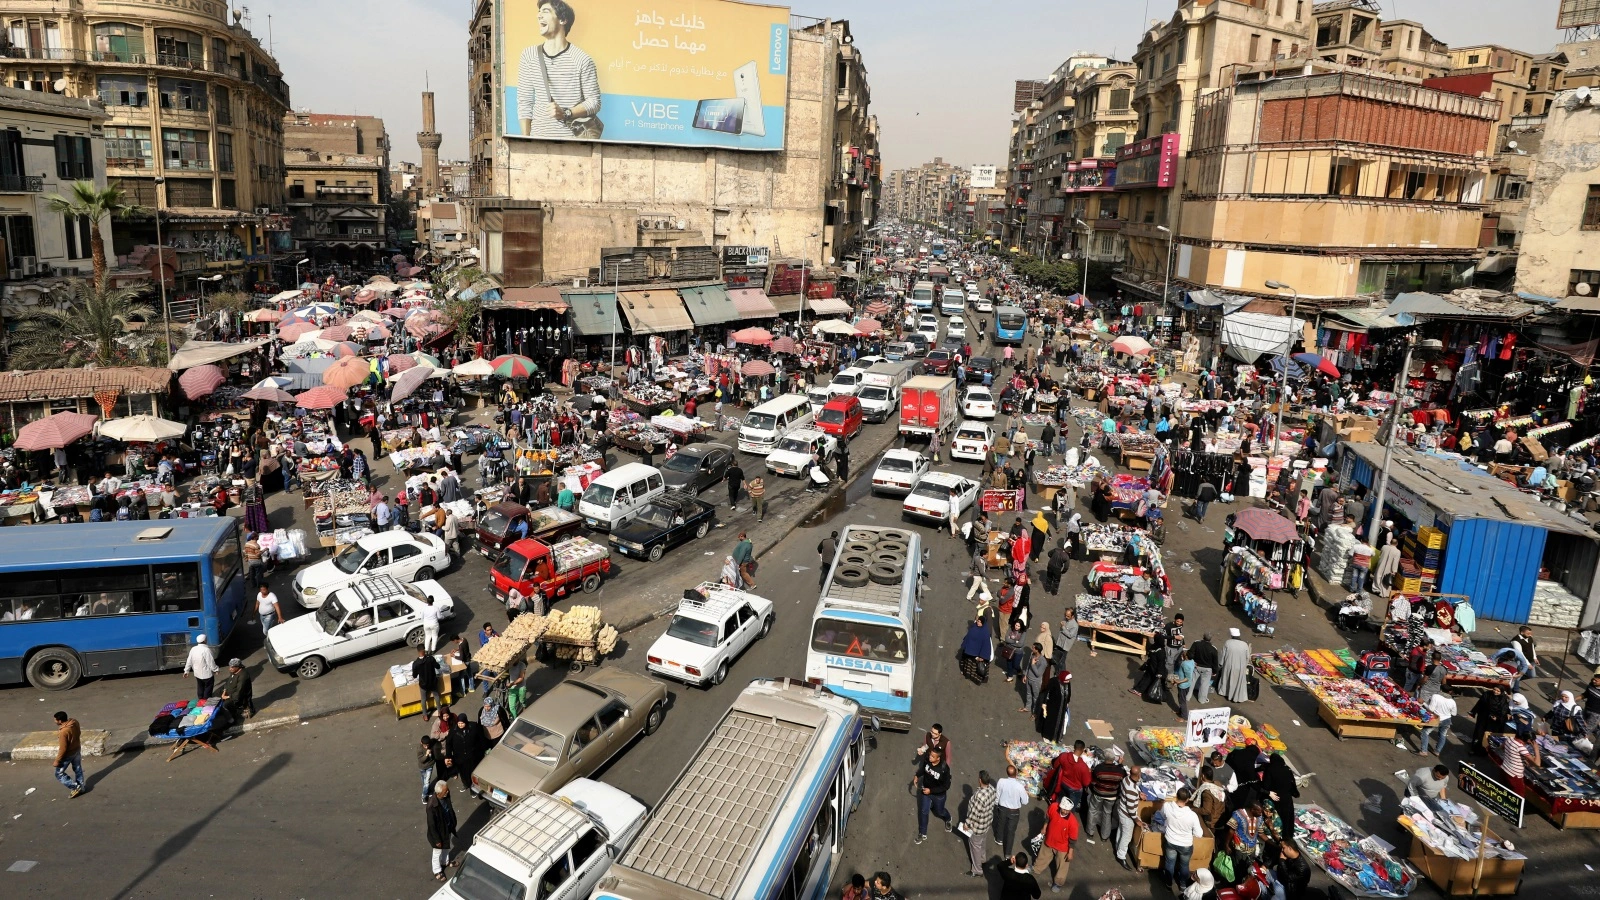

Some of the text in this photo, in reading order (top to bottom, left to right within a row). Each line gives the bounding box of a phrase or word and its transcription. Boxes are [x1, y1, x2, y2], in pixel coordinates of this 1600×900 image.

[634, 9, 705, 32] خليك جاهز
[632, 31, 706, 54] مهما حصل
[771, 27, 782, 70] Lenovo
[633, 64, 647, 72] من
[669, 66, 689, 77] تدوم
[690, 65, 714, 77] بطارية
[715, 71, 728, 80] مع
[631, 101, 679, 120] VIBE
[625, 119, 684, 131] P1 Smartphone
[728, 247, 747, 256] BLACK
[751, 247, 768, 256] WHITE
[825, 655, 893, 673] HASSAAN
